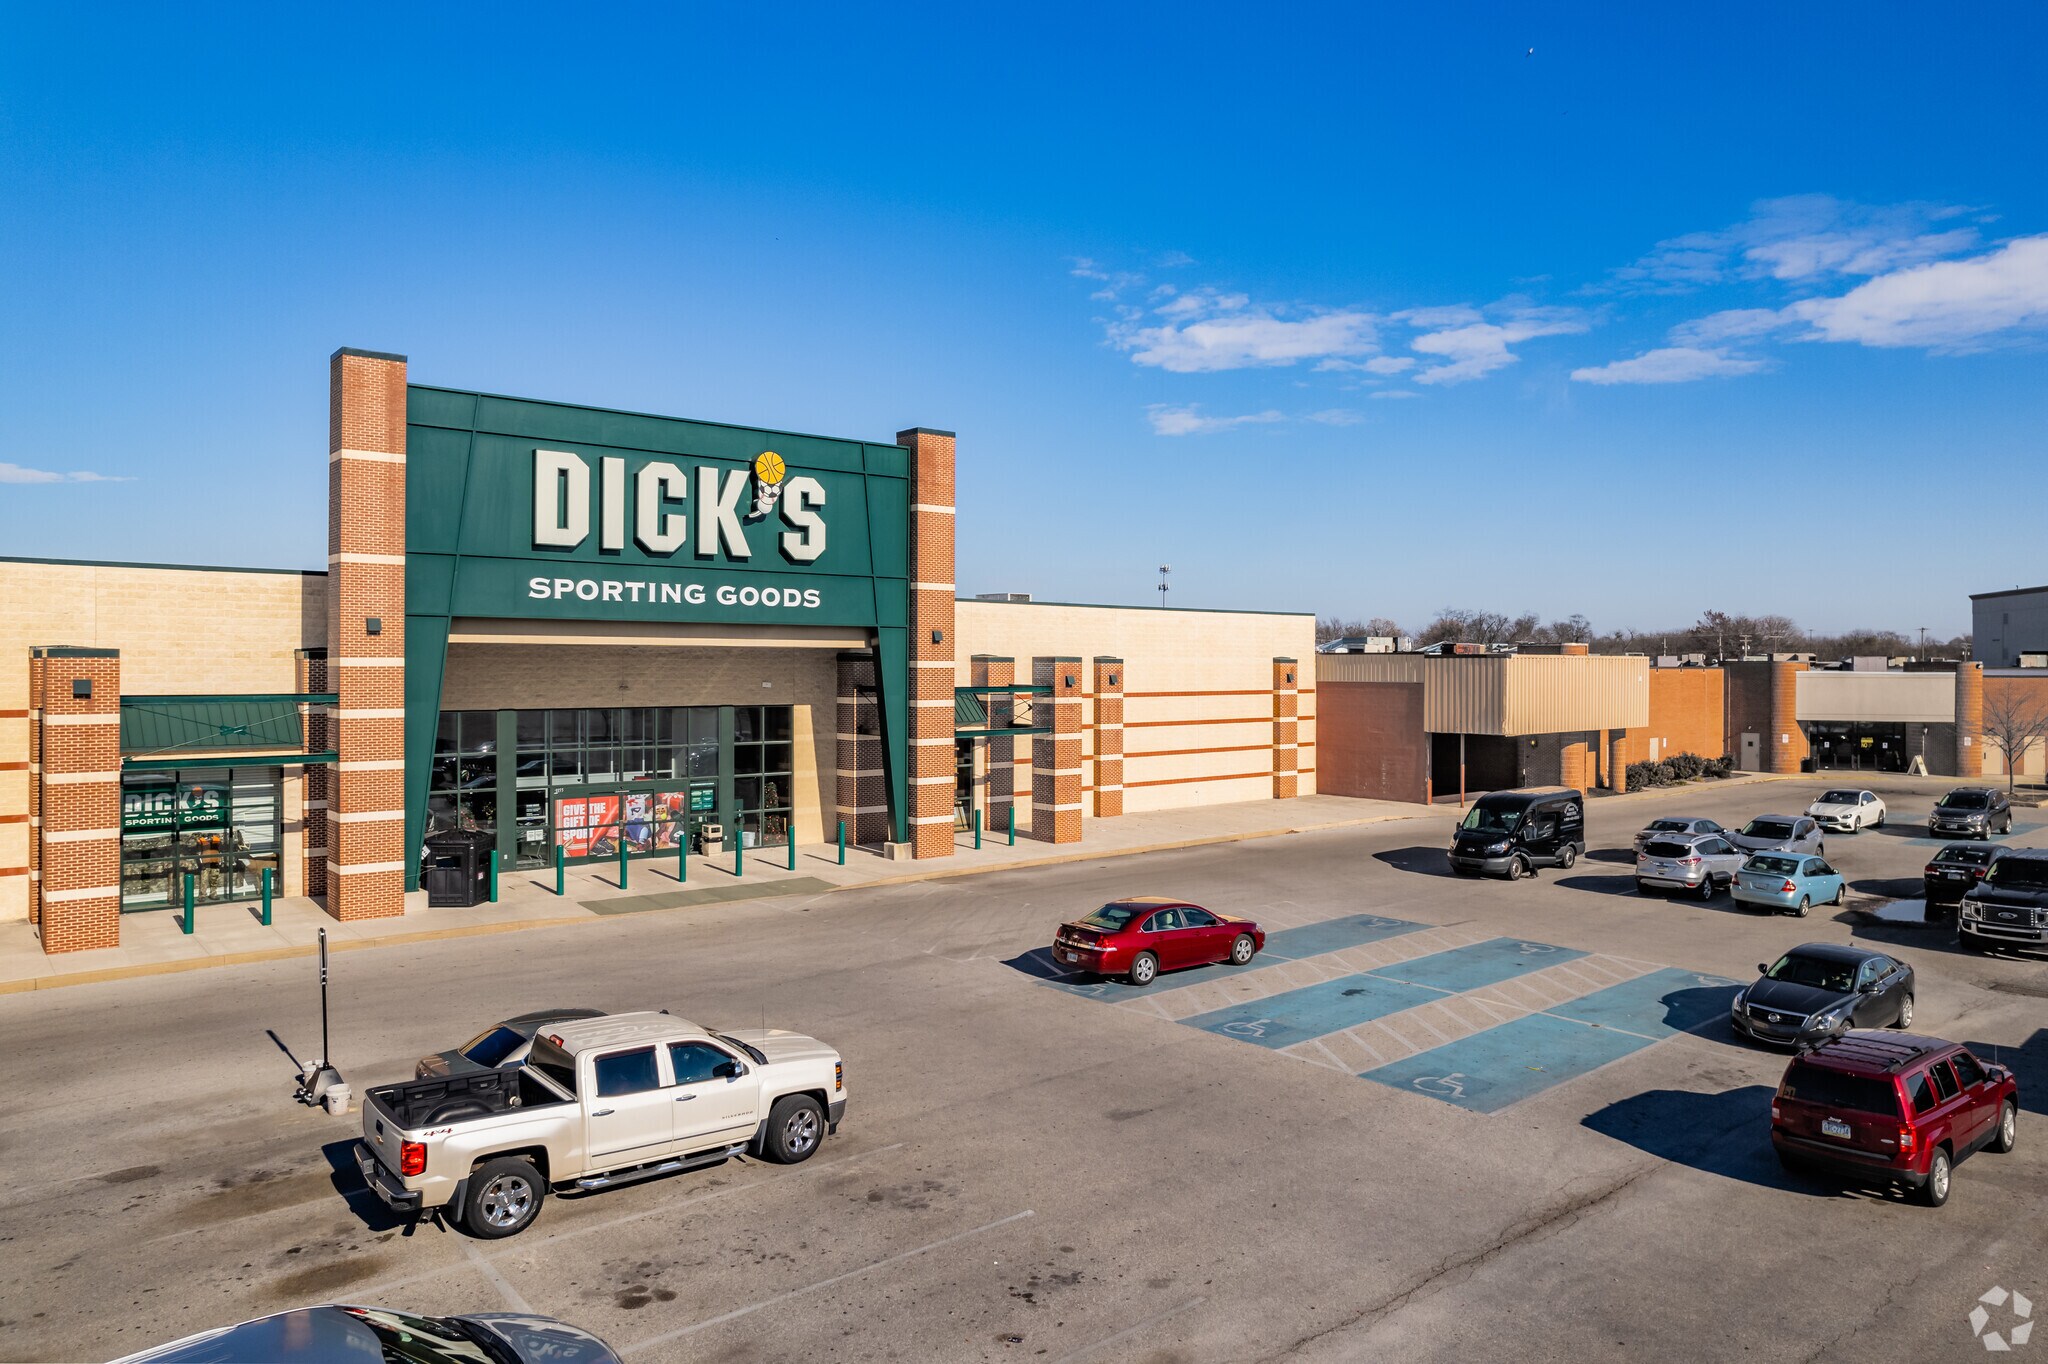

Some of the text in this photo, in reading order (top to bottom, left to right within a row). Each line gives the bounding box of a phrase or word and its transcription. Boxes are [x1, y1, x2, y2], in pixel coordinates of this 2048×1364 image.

[531, 449, 827, 566] DICK'S
[528, 577, 822, 608] SPORTING GOODS
[563, 802, 606, 816] GIVE THE
[563, 815, 600, 828] GIFT OF
